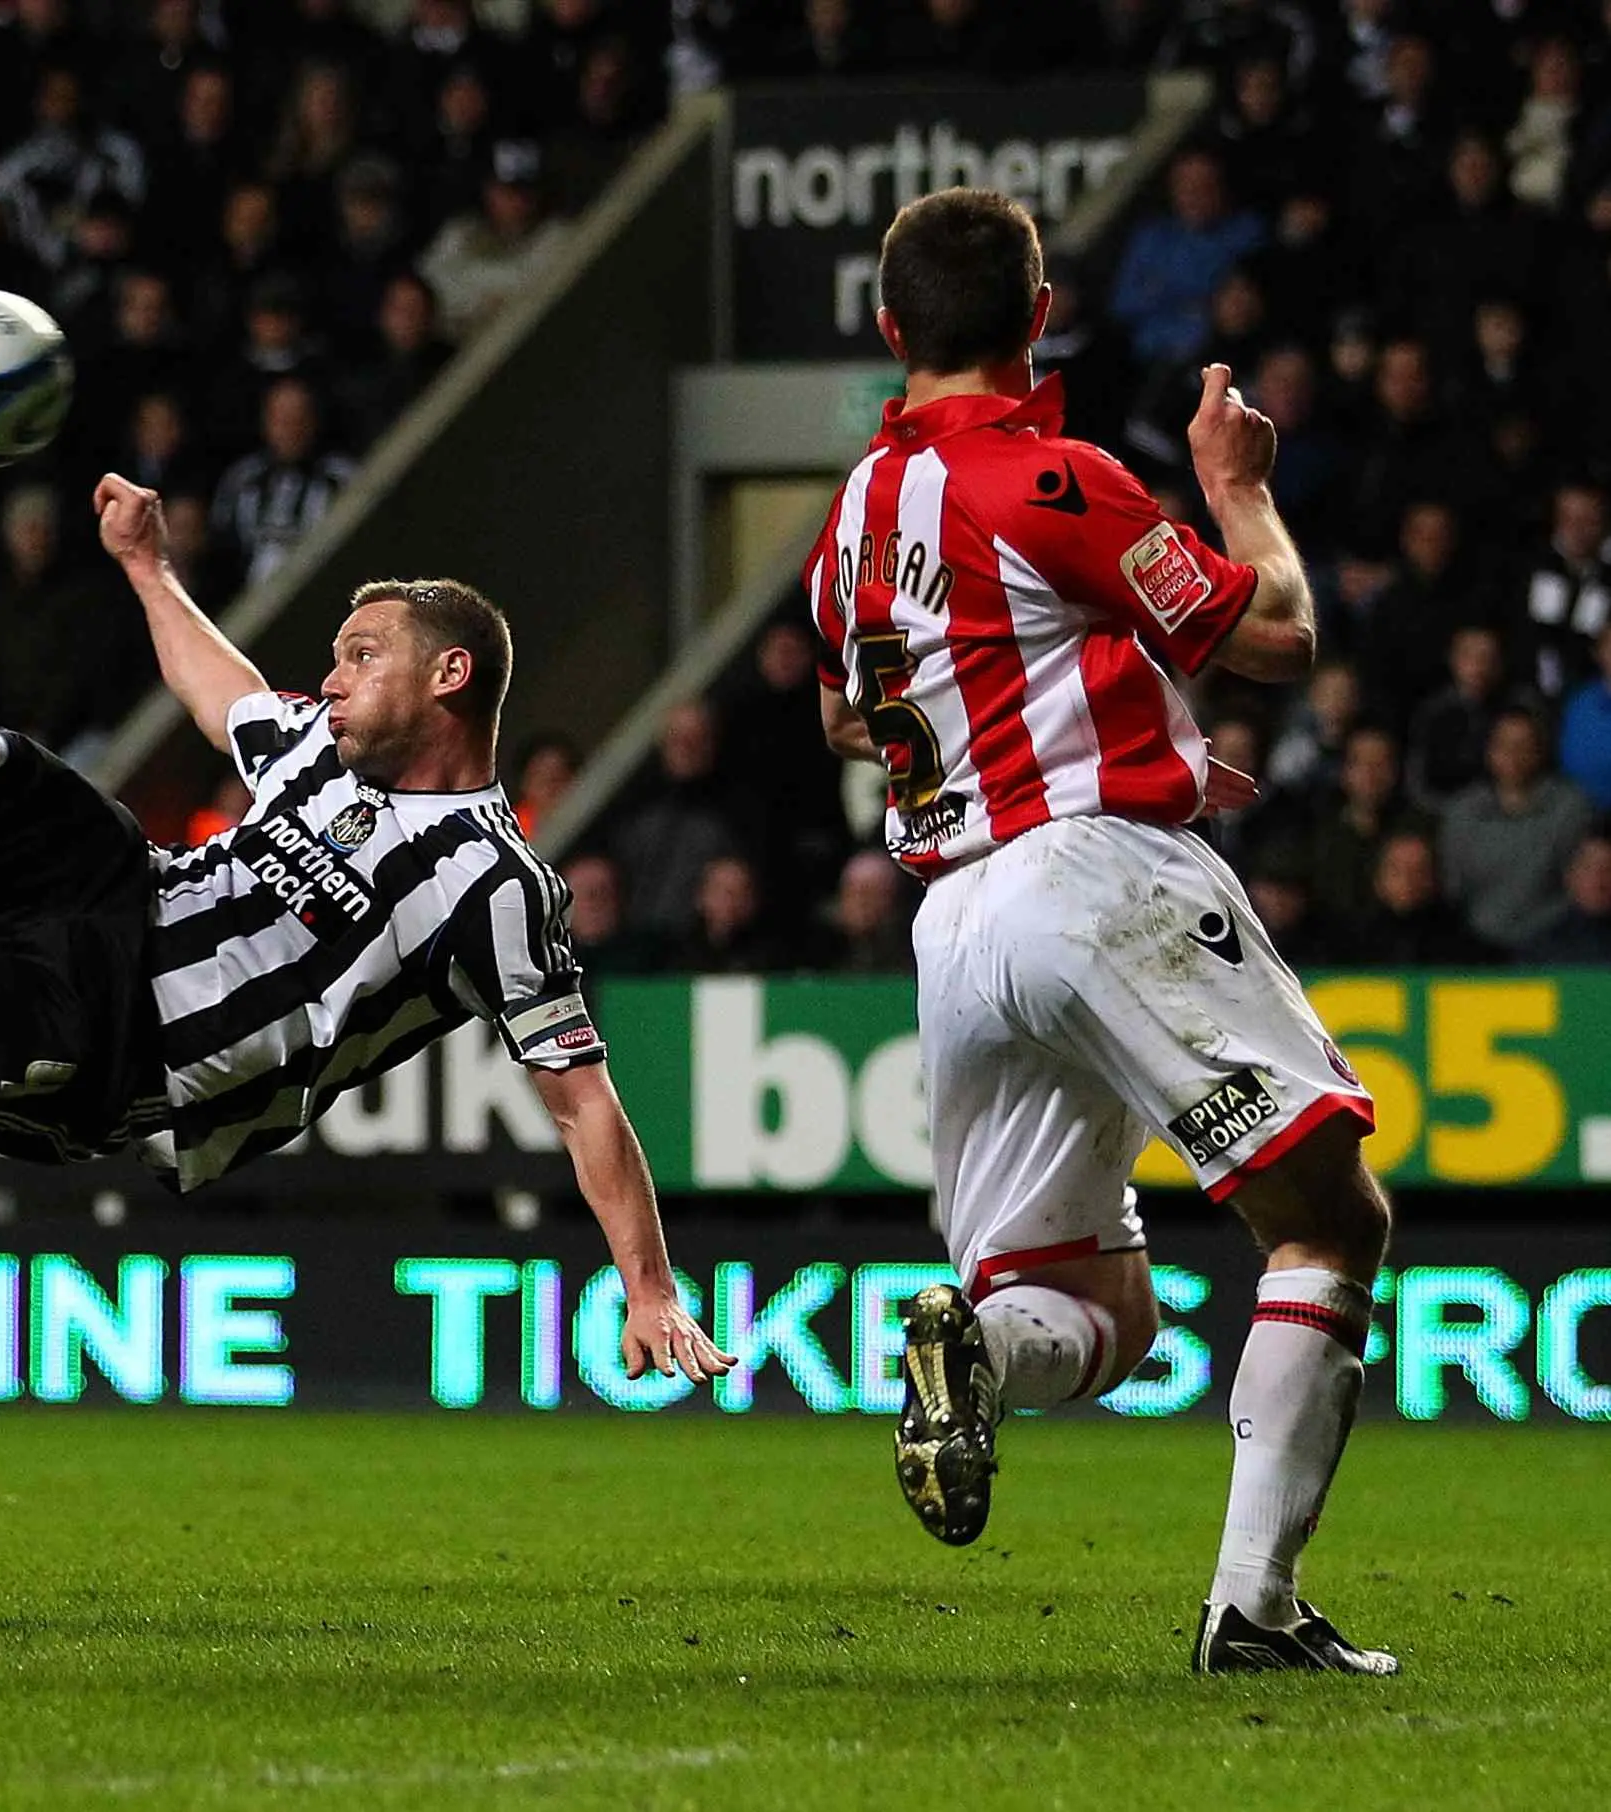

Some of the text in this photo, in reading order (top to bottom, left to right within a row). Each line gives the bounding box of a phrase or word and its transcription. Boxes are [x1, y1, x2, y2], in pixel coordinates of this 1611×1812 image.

[851, 632, 945, 813] 5
[261, 815, 371, 922] northern
[393, 1257, 1213, 1418] TICKES
